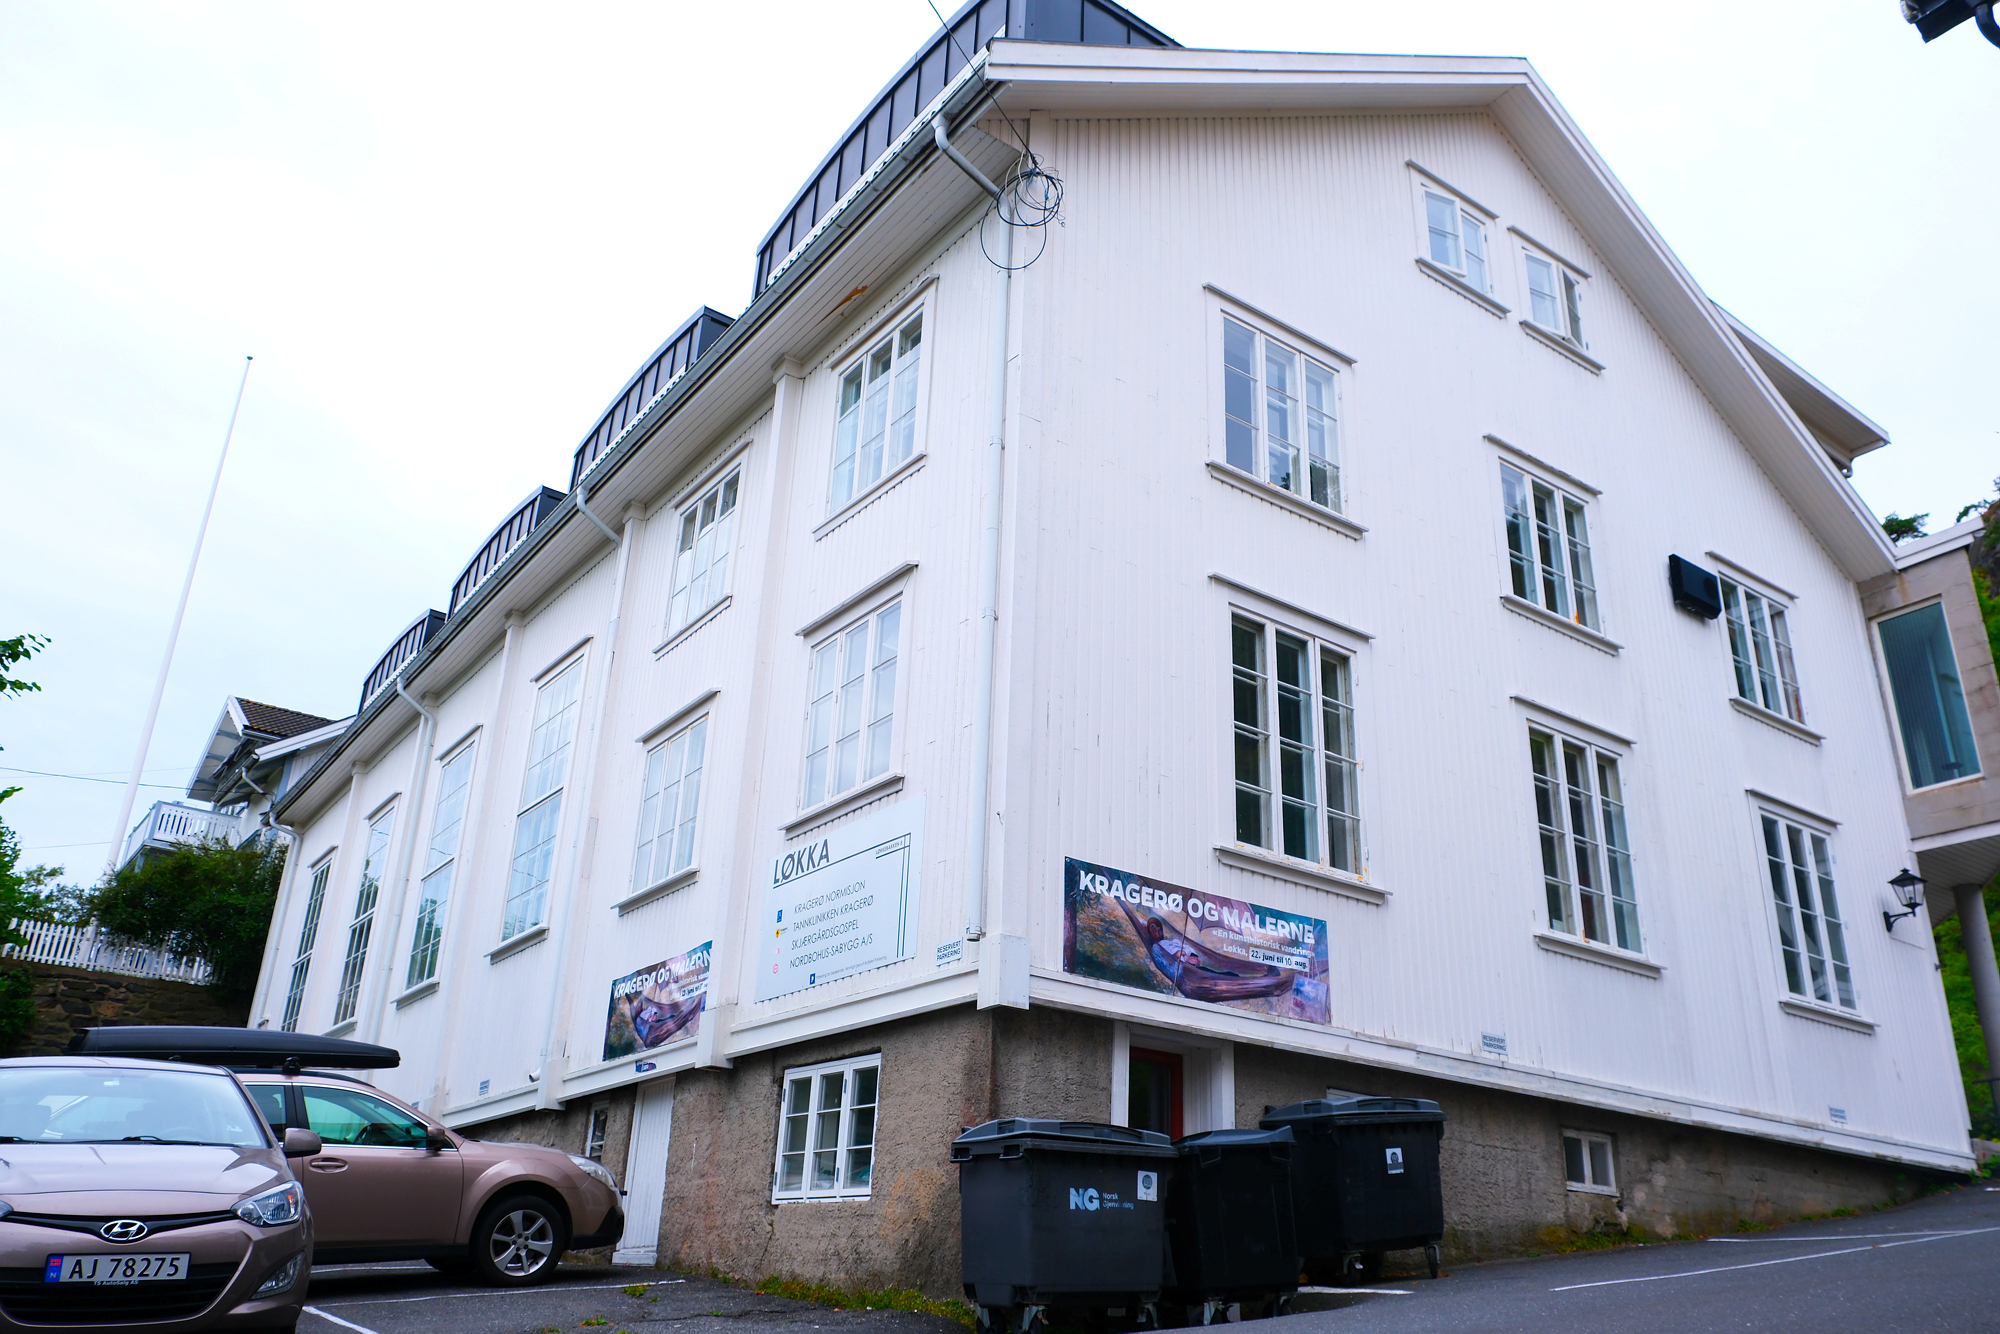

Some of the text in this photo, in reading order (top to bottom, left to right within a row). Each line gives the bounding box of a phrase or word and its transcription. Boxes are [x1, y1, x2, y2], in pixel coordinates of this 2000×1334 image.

[774, 839, 830, 882] LØKKA
[794, 880, 866, 914] KRAGERØ NORMISJON
[1079, 870, 1315, 944] KRAGERØ OG MALERNE
[793, 895, 874, 932] TANNKLINIKKEN KRAGERØ
[791, 919, 859, 950] SKJÆRGÅRDSGOSPEL
[1212, 929, 1228, 938] «En
[1229, 931, 1280, 950] kunsthistorisk
[789, 938, 859, 969] NORDBOHUS-SABYGG
[861, 933, 873, 945] A/S
[937, 940, 961, 953] RESERVERT
[937, 948, 960, 961] PARKERING
[1223, 944, 1248, 956] Løkka,
[1251, 950, 1308, 969] 22. juni til 10 aug.
[1482, 1034, 1506, 1044] RESERVERT
[1483, 1041, 1507, 1051] PARKERING
[1069, 1187, 1100, 1211] NG
[1102, 1192, 1118, 1200] Norsk
[1103, 1201, 1134, 1209] Gjenvining
[68, 1257, 181, 1279] AJ 78275
